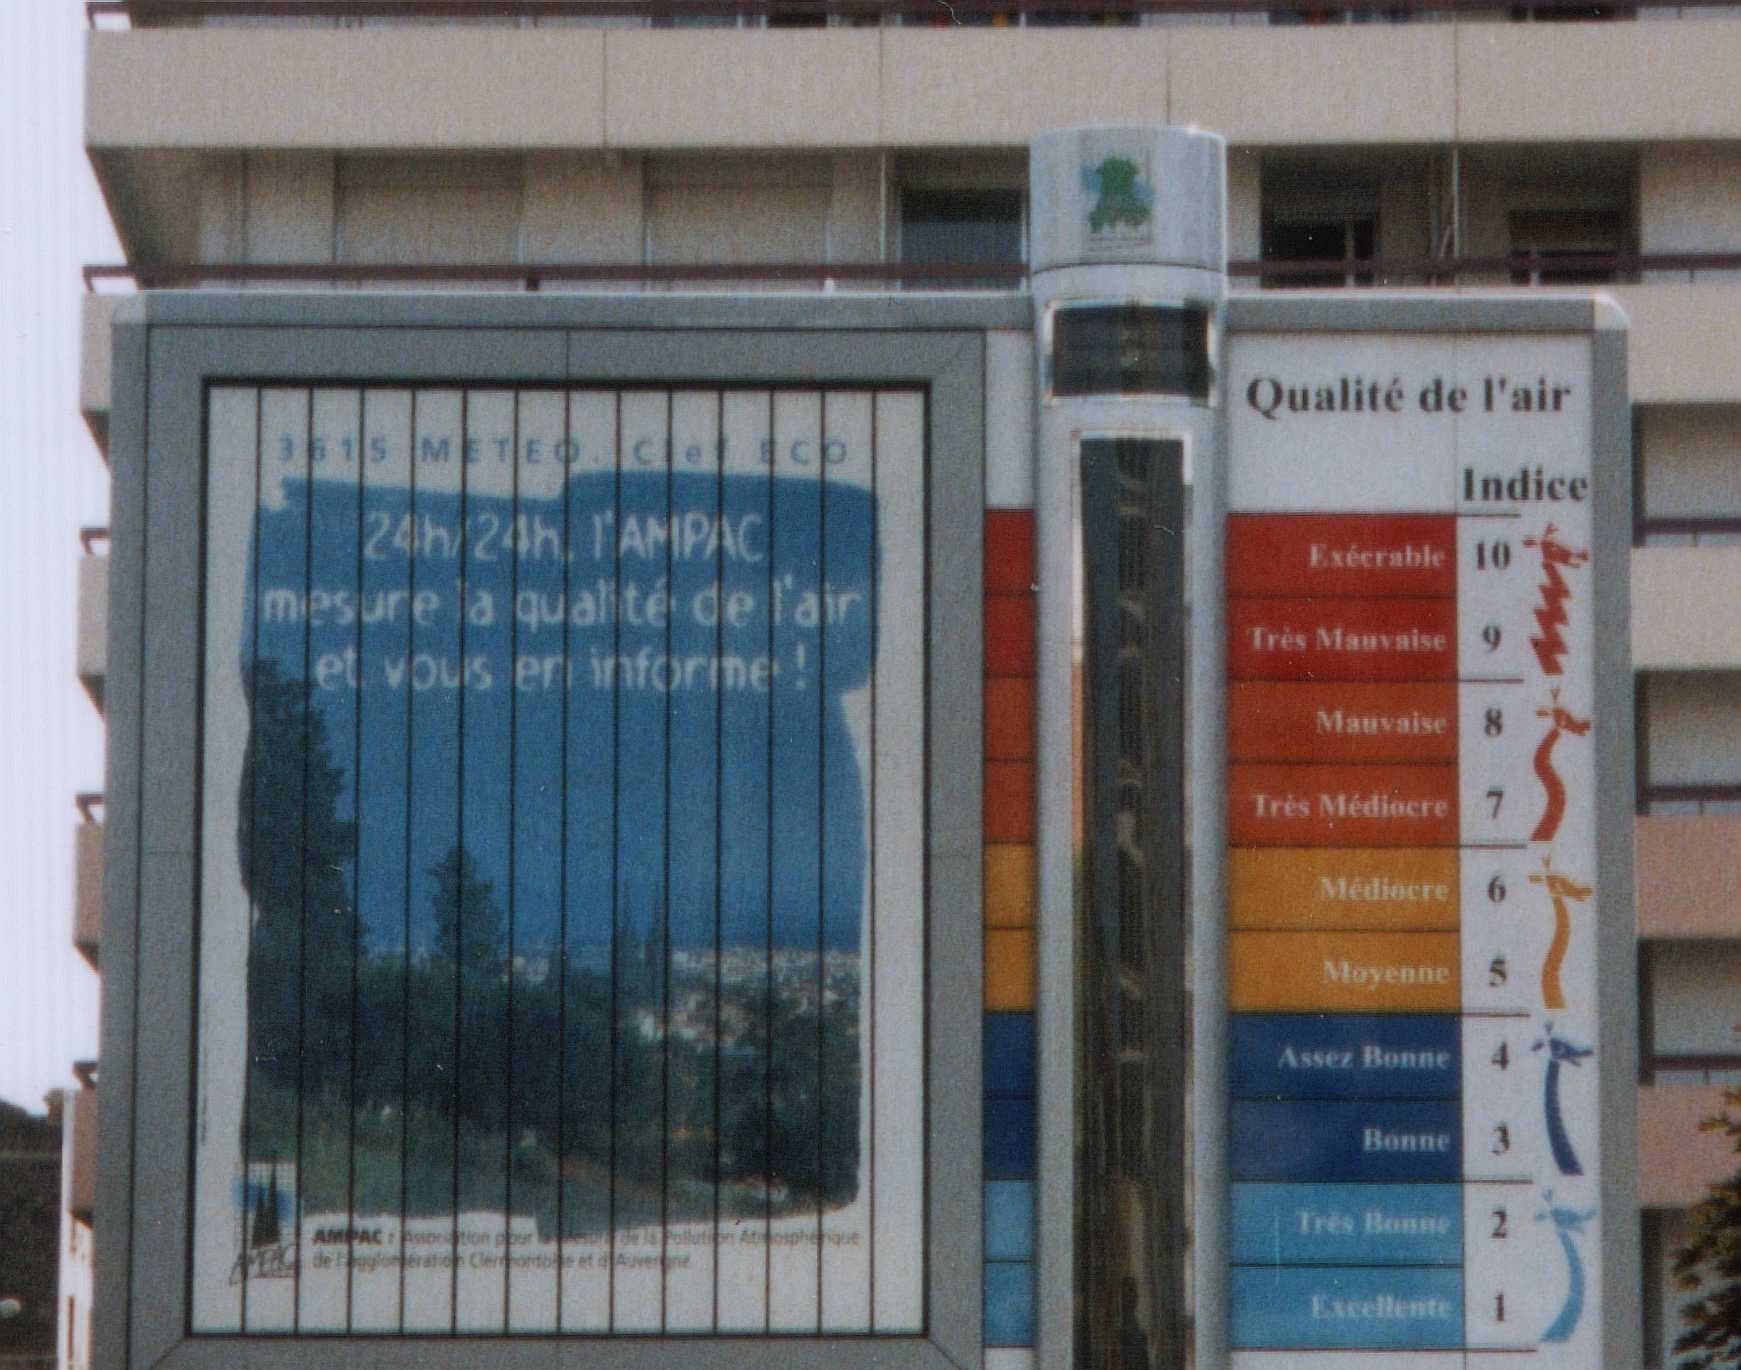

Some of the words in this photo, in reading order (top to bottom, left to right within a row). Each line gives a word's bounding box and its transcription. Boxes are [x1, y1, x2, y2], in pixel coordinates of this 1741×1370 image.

[1246, 375, 1405, 419] Qualité
[1418, 377, 1468, 413] de
[1483, 376, 1571, 413] l'air
[278, 433, 388, 464] 3615
[761, 438, 847, 467] ECO
[1463, 467, 1589, 502] Indice
[592, 510, 765, 562] l'AMPAC
[1308, 542, 1445, 570] Exécrable
[1474, 540, 1510, 571] 10
[263, 584, 441, 626] mesure
[516, 575, 674, 633] qualité
[693, 579, 755, 628] de
[773, 572, 862, 628] l'air
[1315, 626, 1449, 652] Mauvaise
[1483, 625, 1502, 653] 9
[315, 645, 363, 692] et
[385, 652, 494, 692] vous
[515, 653, 573, 692] en
[590, 643, 781, 692] informe
[795, 641, 807, 690] !
[1316, 709, 1448, 735] Mauvaise
[1484, 707, 1503, 737] 8
[1319, 790, 1449, 818] Médiocre
[1486, 791, 1505, 819] 7
[1320, 875, 1450, 903] Médiocre
[1487, 874, 1507, 903] 6
[1322, 959, 1450, 989] Moyenne
[1488, 958, 1508, 988] 5
[1276, 1044, 1354, 1070] Assez
[1362, 1044, 1451, 1070] Bonne
[1490, 1042, 1510, 1072] 4
[1362, 1126, 1451, 1154] Bonne
[1490, 1125, 1511, 1155] 3
[312, 1227, 384, 1246] AMPAC
[1364, 1209, 1451, 1236] Bonne
[1490, 1210, 1508, 1239] 2
[1310, 1291, 1454, 1321] Excellente
[1492, 1294, 1506, 1322] 1
